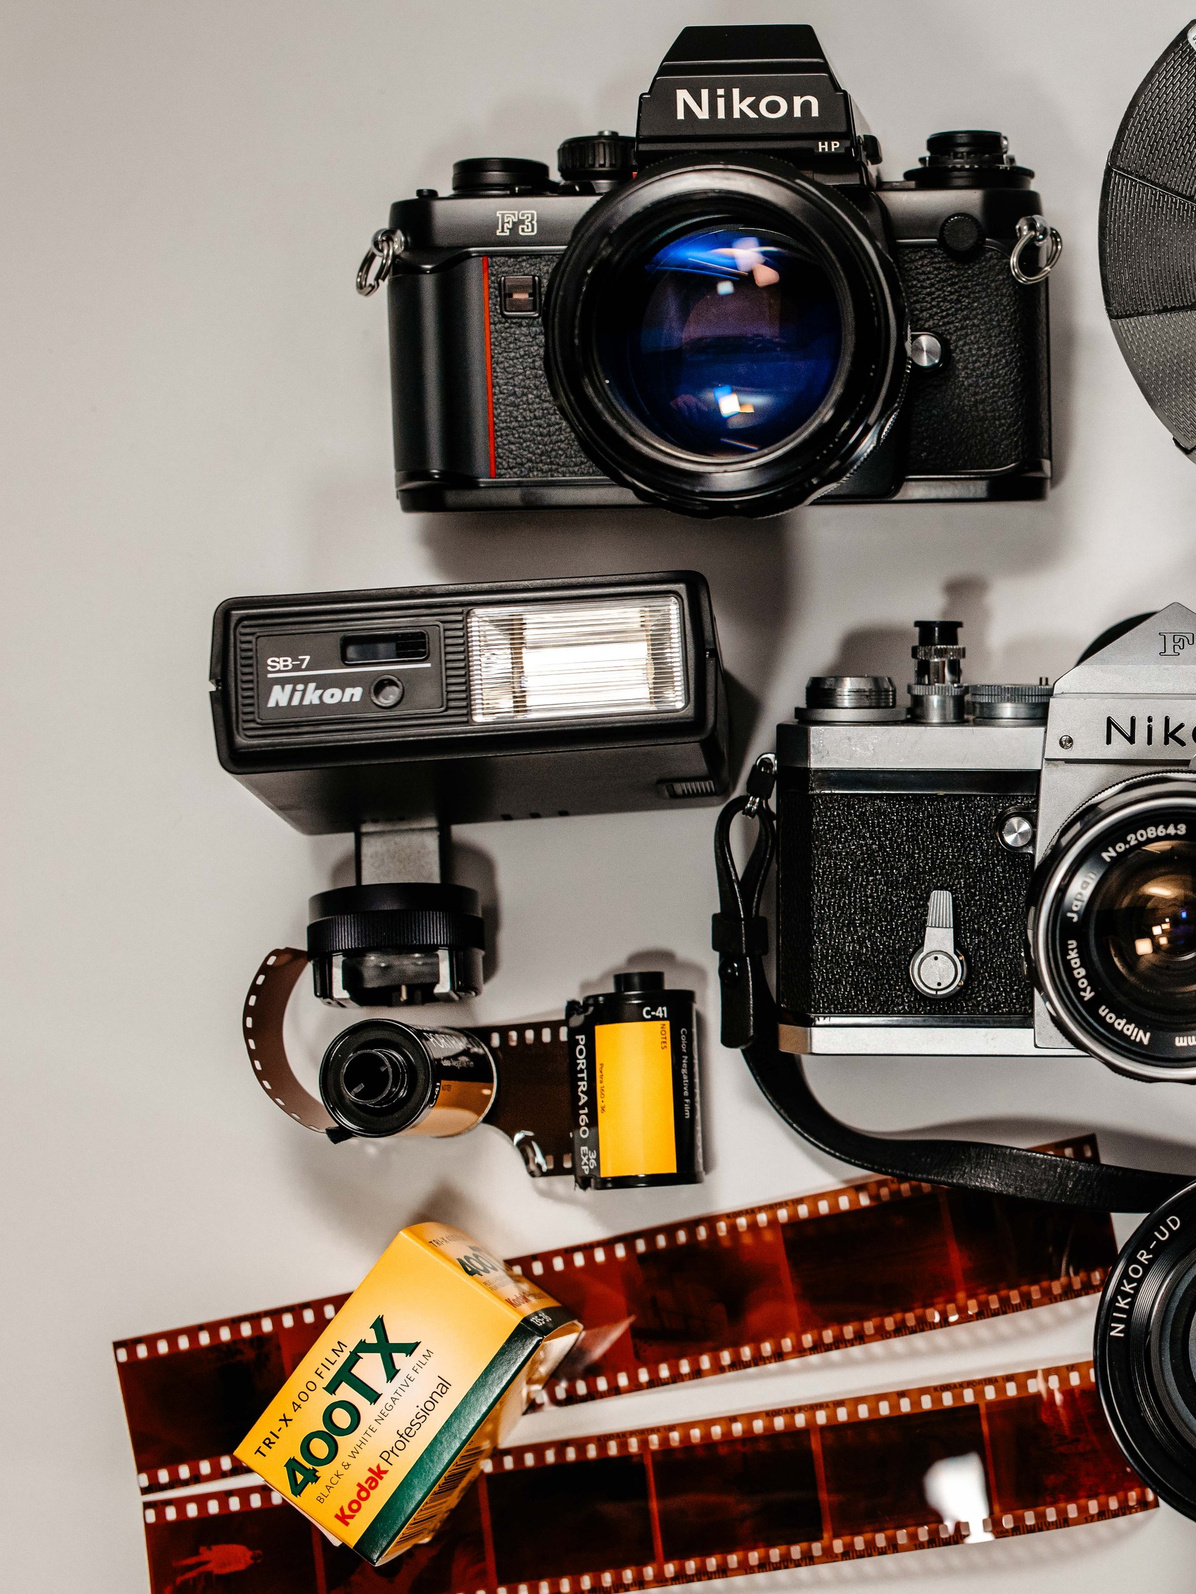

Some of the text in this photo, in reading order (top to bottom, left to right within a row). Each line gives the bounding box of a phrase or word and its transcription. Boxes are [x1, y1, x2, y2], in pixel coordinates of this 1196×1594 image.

[675, 87, 821, 120] Nikon
[817, 140, 841, 152] HP
[496, 210, 538, 237] F3
[1158, 631, 1195, 657] F
[266, 654, 311, 672] SB-7
[267, 681, 363, 709] Nikon
[1101, 823, 1187, 863] No.208643
[1067, 939, 1096, 1002] Kogaku
[642, 1006, 668, 1020] C-41
[1098, 1004, 1151, 1046] Nippon
[660, 1023, 668, 1050] NOTES
[680, 1028, 688, 1054] Color
[575, 1035, 590, 1139] PORTRA 160
[681, 1055, 690, 1098] Negative
[580, 1146, 590, 1175] EXP
[587, 1149, 597, 1169] 36
[726, 1209, 755, 1219] KODAK
[758, 1202, 789, 1212] PORTRA
[1109, 1214, 1182, 1338] NIKKOR-UD
[933, 1382, 964, 1393] KODAK
[967, 1378, 999, 1388] PORTRA
[254, 1340, 349, 1460] TRI-X 400 FILM
[283, 1314, 423, 1499] 400TX
[765, 1408, 795, 1418] KODAK
[798, 1403, 831, 1413] PORTRA
[315, 1348, 435, 1506] BLACK & WHITE NEGATIVE FILM
[597, 1431, 627, 1442] KODAK
[333, 1374, 453, 1528] Kodak Professional
